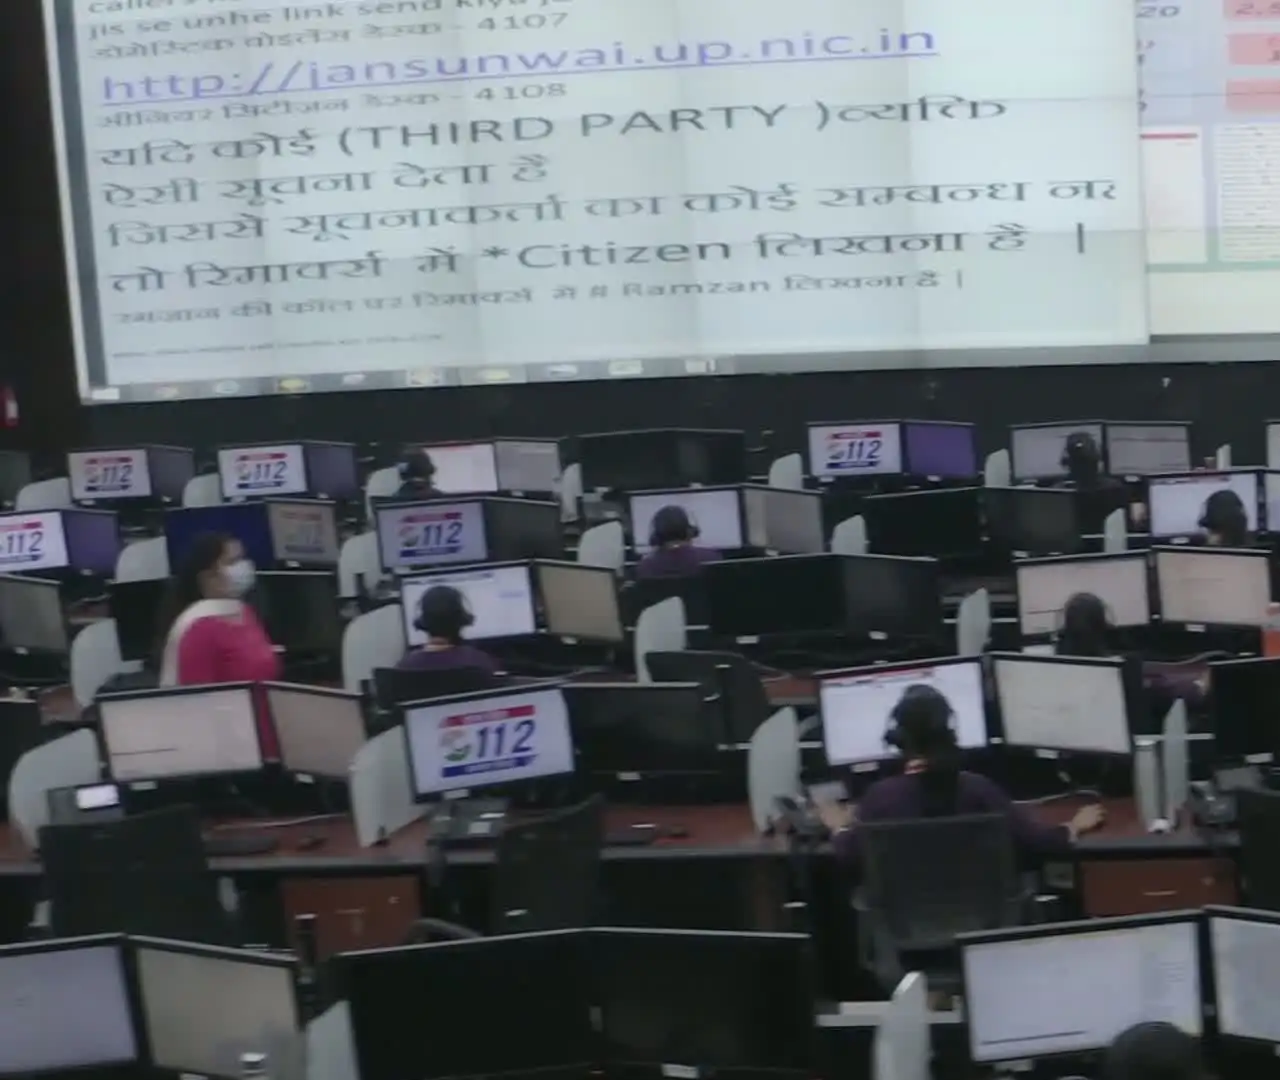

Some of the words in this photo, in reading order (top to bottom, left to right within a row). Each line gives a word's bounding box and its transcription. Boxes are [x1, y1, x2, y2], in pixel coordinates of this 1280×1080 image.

[90, 22, 124, 41] jis
[137, 20, 172, 32] se
[183, 11, 272, 30] unhe
[284, 3, 343, 22] link
[357, 0, 441, 16] send
[477, 12, 568, 31] 4107
[473, 82, 568, 101] 4108
[211, 128, 318, 158] कोई
[338, 115, 555, 157] (THIRD
[581, 103, 788, 138] PARTY
[103, 178, 202, 208] ऐसी
[393, 161, 496, 188] देता
[511, 154, 548, 182] है
[107, 213, 267, 247] जिससे
[584, 197, 666, 217] का
[681, 183, 799, 212] कोई
[112, 266, 172, 293] तो
[753, 232, 969, 259] लिखना
[984, 223, 1030, 252] है
[623, 277, 772, 297] Ramzan
[846, 439, 884, 462] 112
[100, 464, 134, 484] 112
[253, 459, 287, 481] 112
[420, 521, 464, 546] 112
[473, 720, 536, 758] 112
